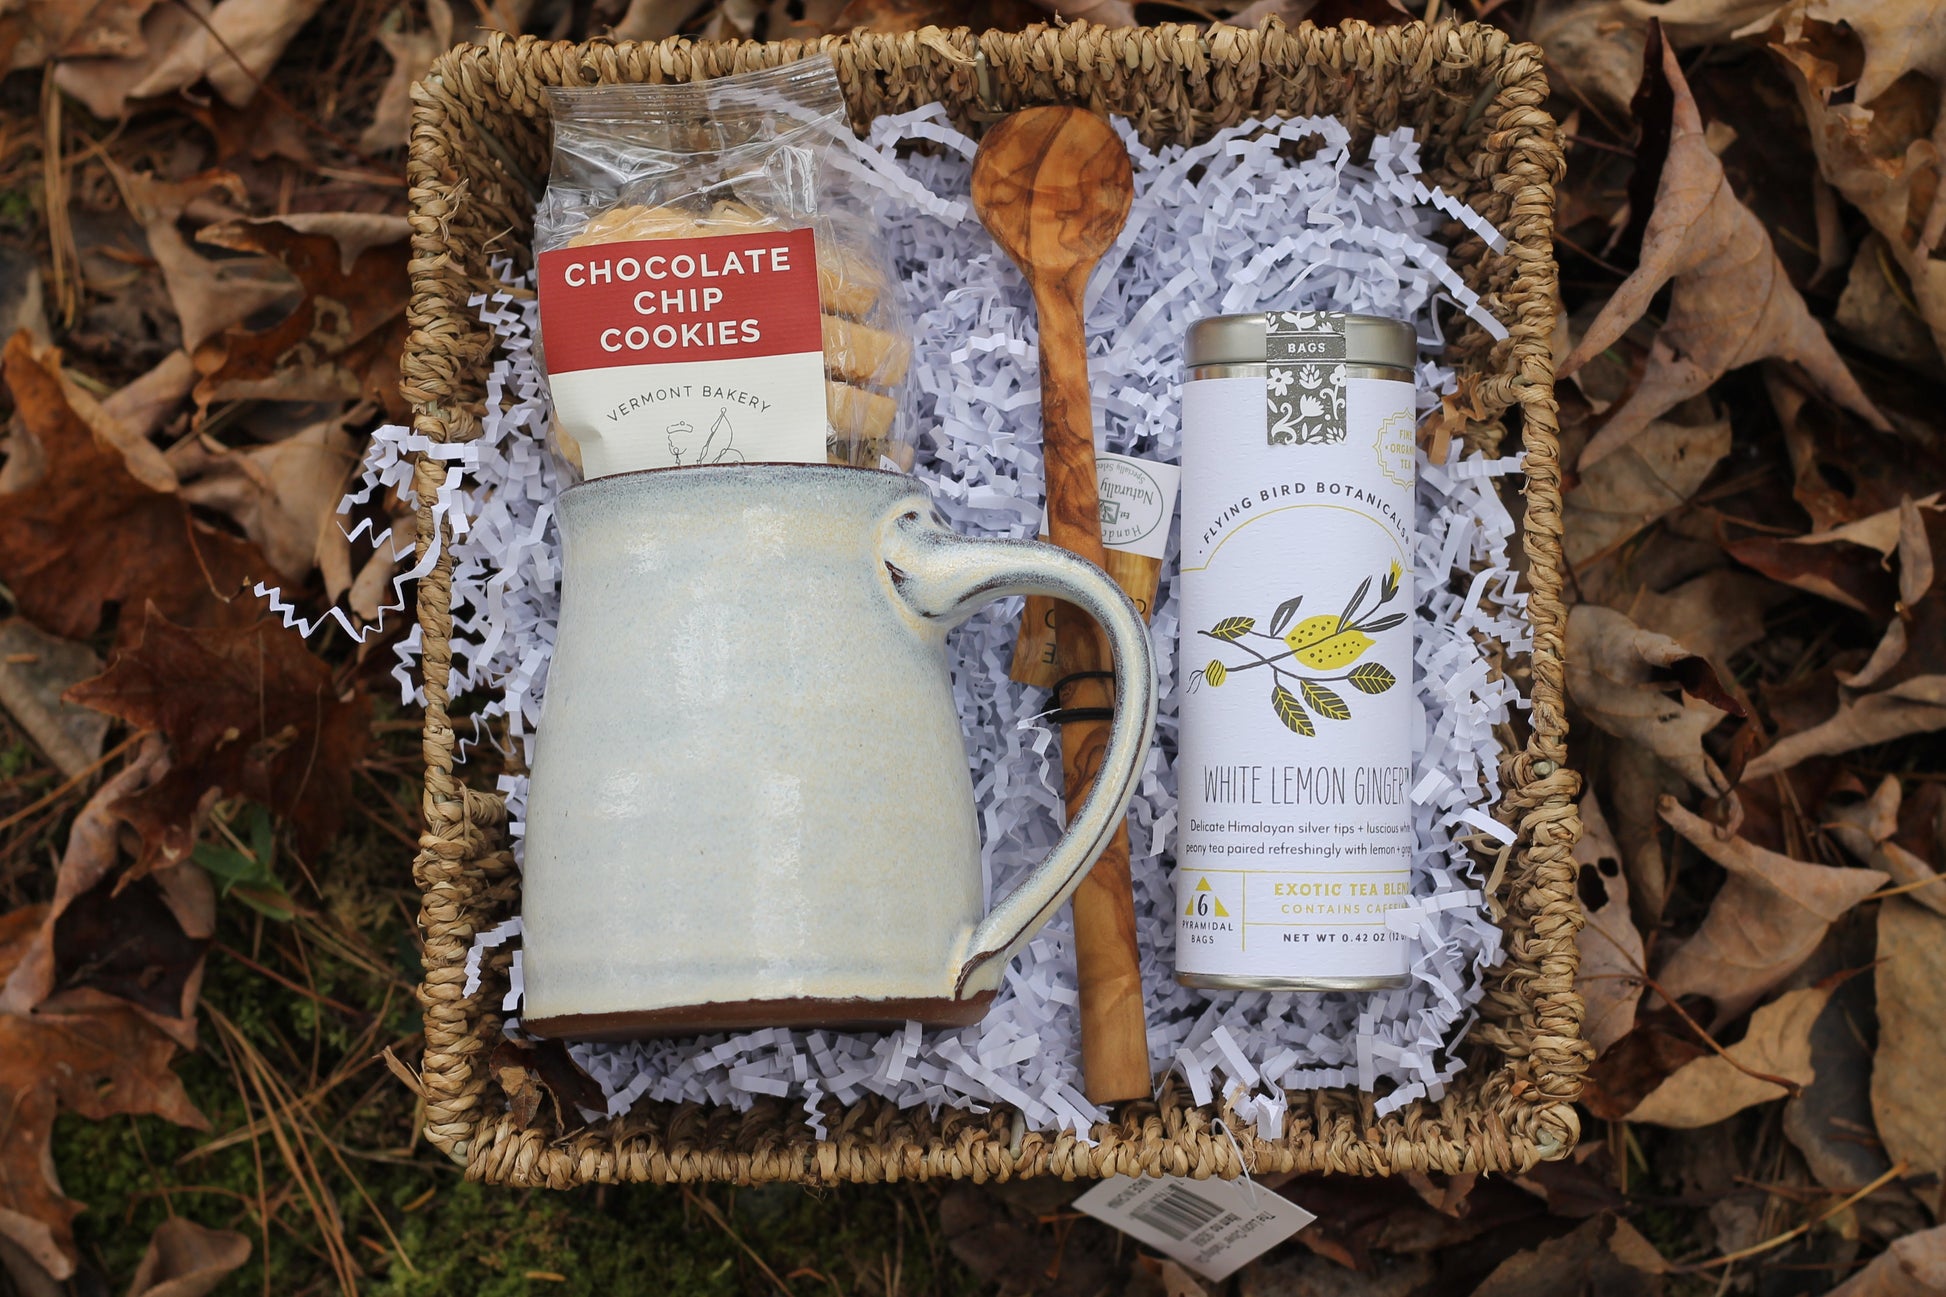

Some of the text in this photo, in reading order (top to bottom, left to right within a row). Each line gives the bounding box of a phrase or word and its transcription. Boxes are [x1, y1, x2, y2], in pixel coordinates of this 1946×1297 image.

[564, 247, 791, 287] CHOCOLATE
[633, 287, 723, 315] CHIP
[600, 318, 761, 352] COOKIES
[1288, 342, 1326, 353] BAGS
[607, 385, 772, 423] VERMONT BAKERY
[1400, 430, 1412, 441] FINE
[1401, 459, 1411, 470] TEA
[1100, 477, 1154, 505] Naturally
[1203, 497, 1252, 544] FLYING
[1260, 482, 1306, 501] BIRD
[1204, 765, 1262, 804] WHITE
[1272, 766, 1345, 805] LEMON
[1190, 819, 1225, 833] Delicate
[1228, 820, 1294, 837] Himalayan
[1298, 820, 1330, 834] silver
[1334, 821, 1355, 837] tips
[1366, 821, 1399, 834] luscious
[1186, 843, 1206, 856] peony
[1209, 843, 1224, 854] tea
[1227, 843, 1265, 856] paired
[1268, 842, 1342, 858] refreshingly
[1344, 842, 1367, 855] with
[1370, 843, 1396, 855] lemon
[1274, 883, 1341, 897] EXOTIC
[1350, 883, 1378, 896] TEA
[1197, 893, 1208, 917] 6
[1281, 904, 1360, 914] CONTAINS
[1182, 920, 1234, 932] PYRAMIDAL
[1191, 934, 1214, 944] BAGS
[1283, 933, 1309, 943] NET
[1316, 933, 1336, 943] WT
[1342, 933, 1368, 943] 0.42
[1373, 932, 1385, 942] OZ
